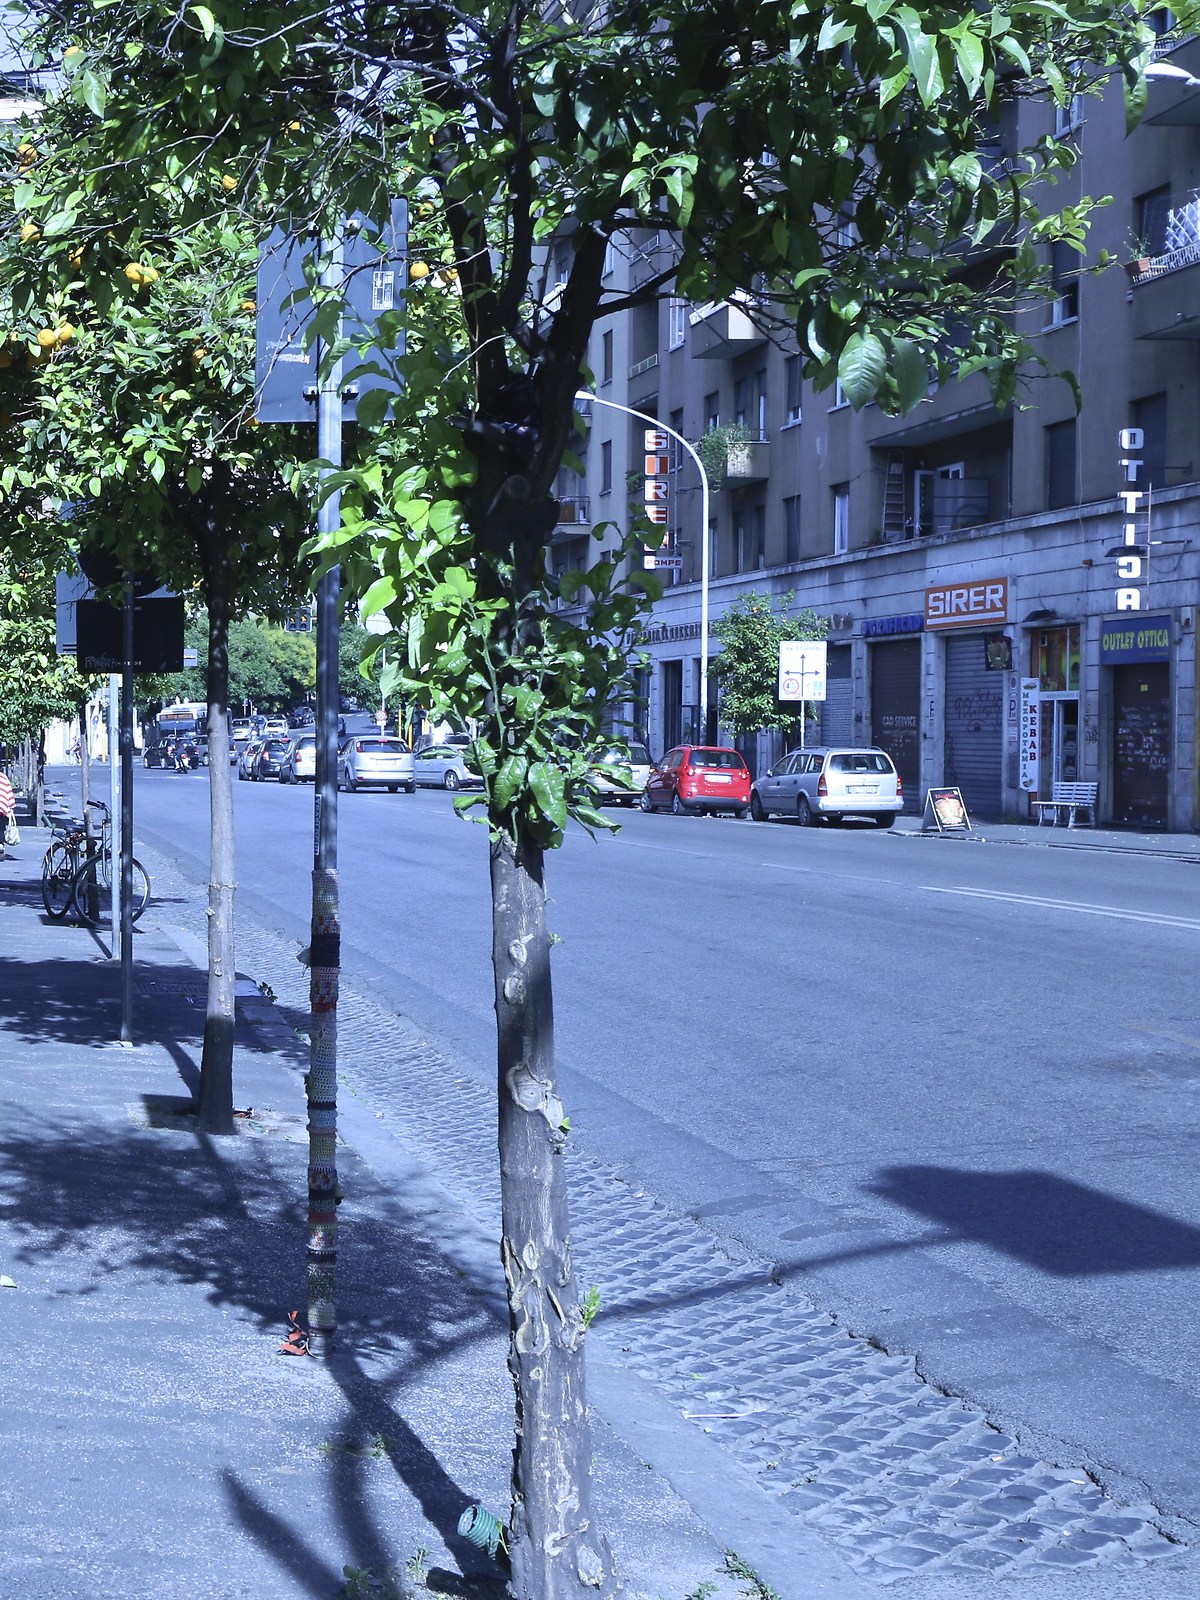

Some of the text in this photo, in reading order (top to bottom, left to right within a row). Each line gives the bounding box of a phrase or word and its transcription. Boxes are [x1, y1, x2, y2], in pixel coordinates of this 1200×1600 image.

[646, 430, 669, 550] SIRE
[928, 584, 1004, 616] SIRER
[1103, 629, 1169, 650] OUTLET OTTICA
[1021, 692, 1030, 778] MEZOPOTAMIA
[1029, 705, 1038, 761] KEBAB
